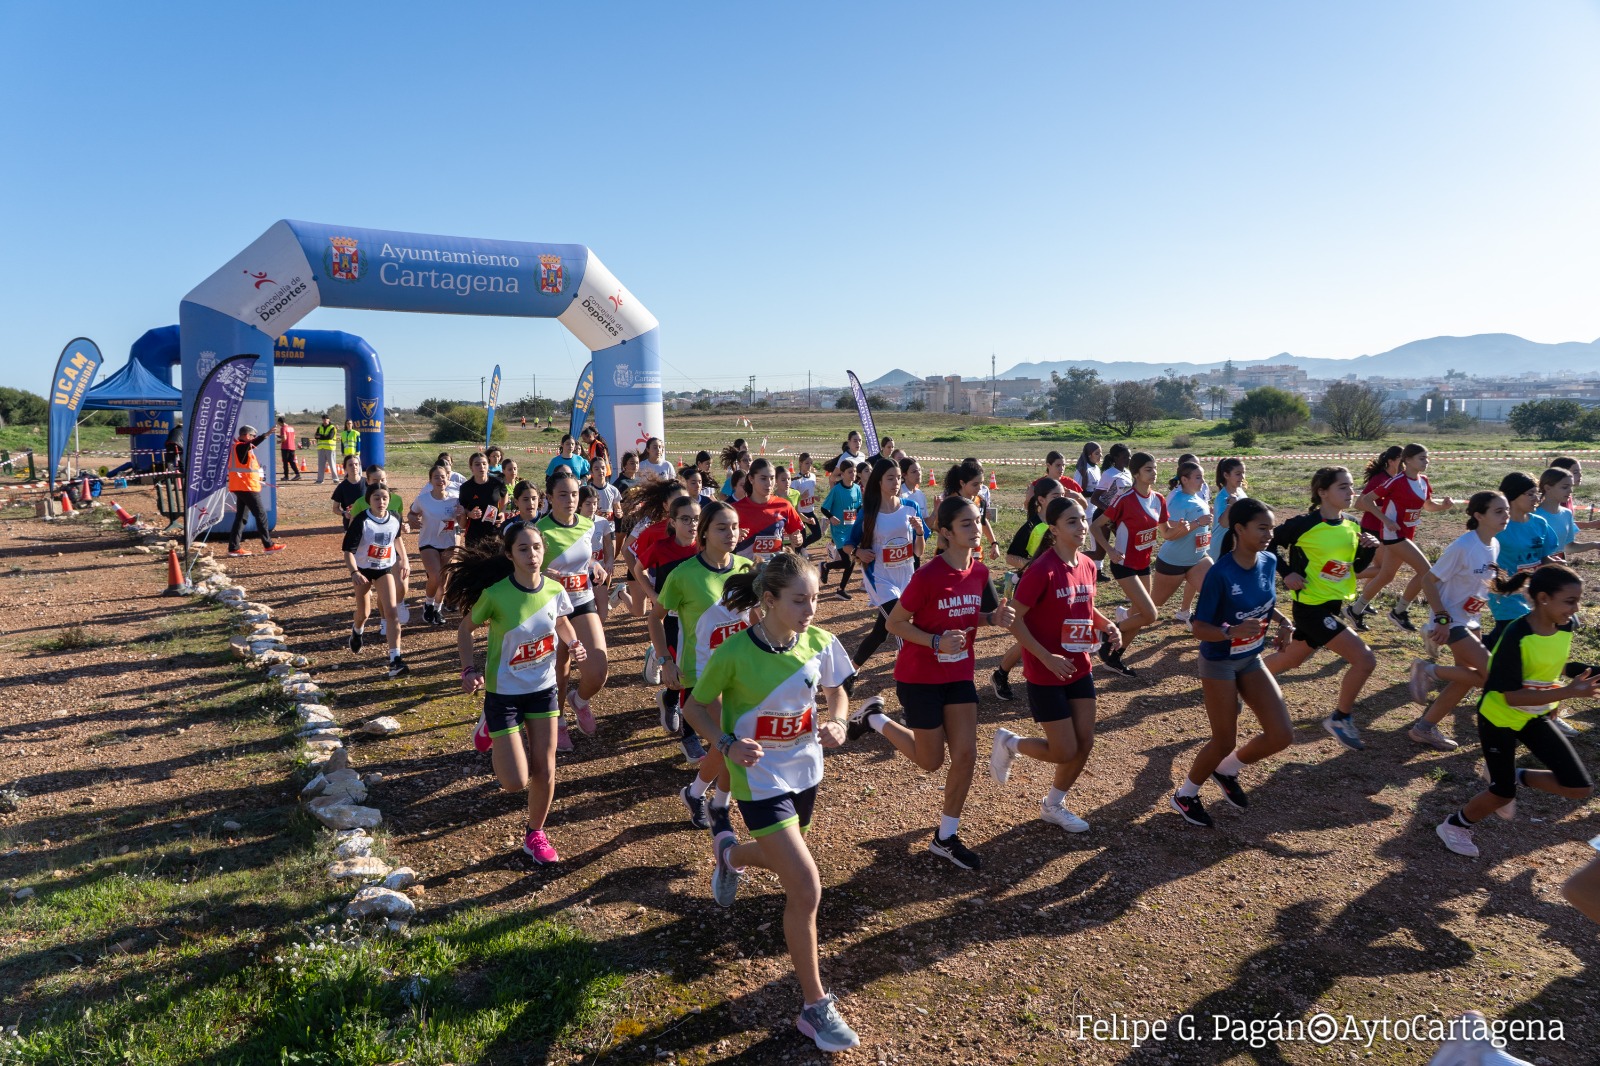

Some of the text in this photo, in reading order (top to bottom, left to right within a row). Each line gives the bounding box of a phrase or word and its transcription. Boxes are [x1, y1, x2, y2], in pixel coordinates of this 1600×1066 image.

[380, 243, 520, 268] Ayuntamiento
[291, 276, 300, 286] de
[380, 262, 520, 296] Cartagena
[260, 282, 307, 321] Deportes
[582, 299, 619, 336] Deportes
[616, 323, 624, 332] de
[274, 350, 305, 359] RSIDAD
[55, 352, 89, 405] UCAM
[67, 359, 96, 411] UNIVERSIDAD
[190, 396, 212, 492] Ayuntamiento
[201, 398, 228, 492] Cartagena
[756, 540, 775, 550] 259
[889, 547, 908, 559] 204
[562, 576, 581, 588] 153
[938, 596, 962, 610] ALMA
[948, 606, 976, 617] COLEGIOS
[1069, 625, 1093, 639] 274
[519, 640, 545, 659] 154
[770, 716, 804, 736] 155
